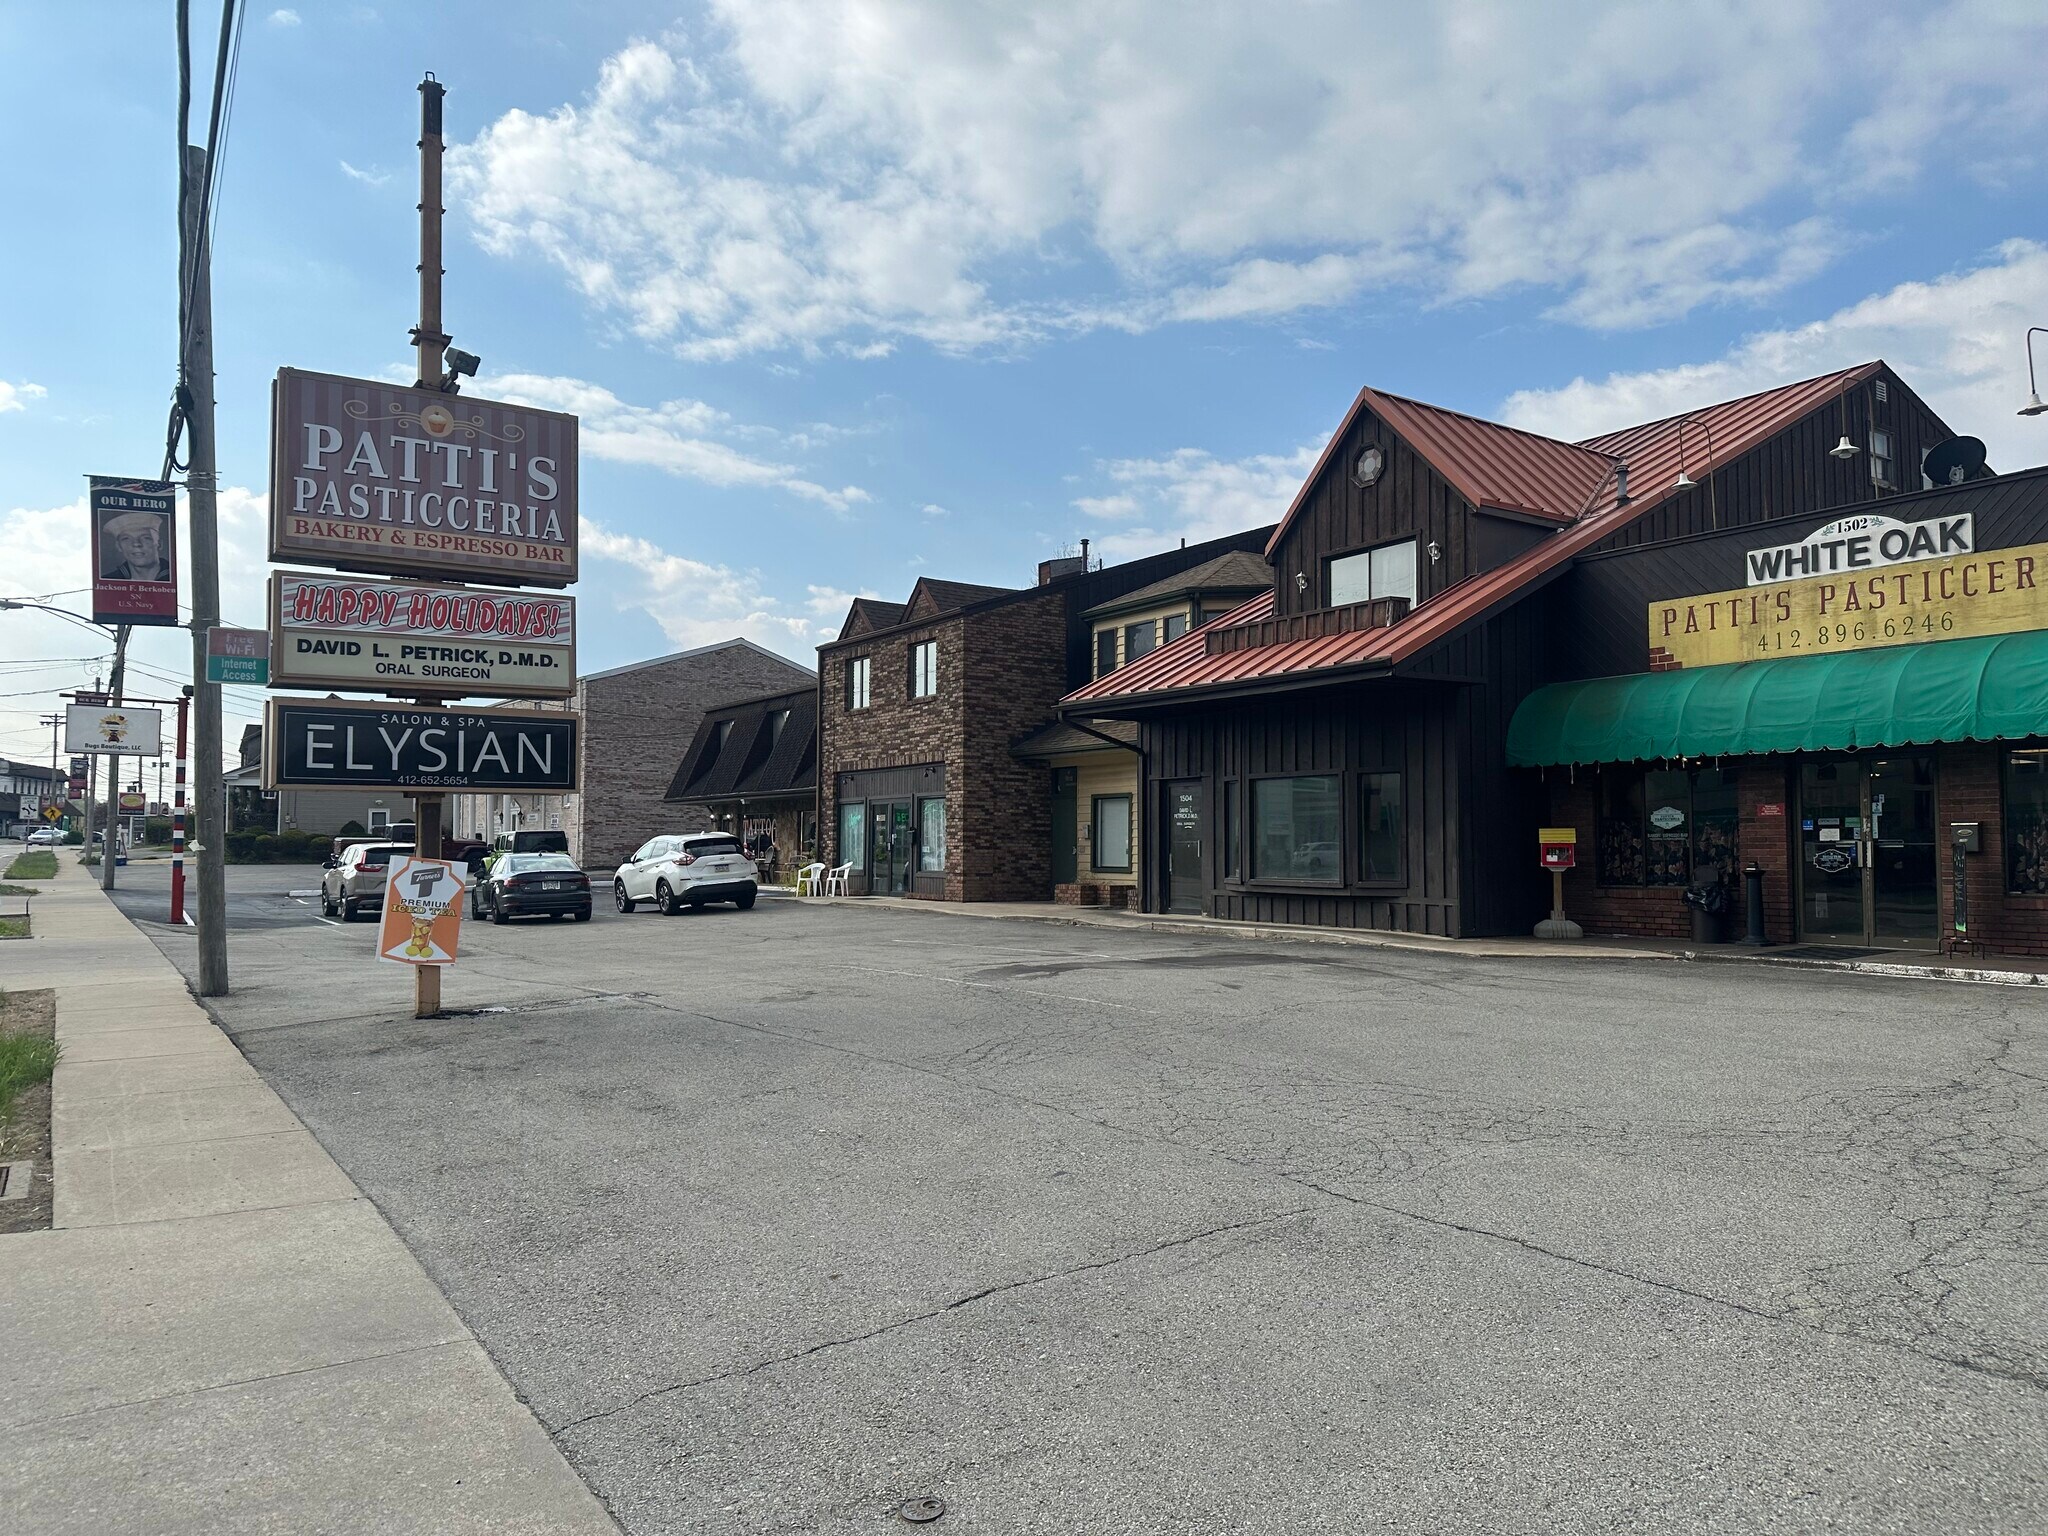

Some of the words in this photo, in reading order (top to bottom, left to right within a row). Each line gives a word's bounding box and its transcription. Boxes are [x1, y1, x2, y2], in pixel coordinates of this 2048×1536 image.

[302, 422, 559, 500] PATTI'S
[100, 496, 128, 507] OUR
[133, 498, 167, 509] HERO
[292, 476, 565, 542] PASTICCERIA
[1836, 516, 1869, 535] 1502
[294, 518, 385, 543] BAKERY
[390, 530, 406, 545] &
[413, 532, 519, 558] ESPRESSO
[525, 545, 565, 562] BAR
[1748, 536, 1871, 581] WHITE
[1879, 517, 1968, 561] OAK
[95, 583, 127, 591] Jackson
[1661, 588, 1792, 637] PATTI'S
[1818, 555, 2037, 615] PASTICCER
[292, 584, 399, 627] HAPPY
[407, 592, 561, 639] HOLIDAYS!
[226, 633, 255, 644] Free
[1757, 611, 1955, 652] 412.896.6246
[225, 644, 256, 656] Wi-Fi
[296, 638, 362, 656] DAVID
[372, 643, 390, 658] L.
[400, 645, 495, 667] PETRICK,
[498, 651, 560, 668] D.M.D.
[221, 658, 257, 670] Internet
[375, 662, 415, 676] ORAL
[421, 664, 491, 680] SURGEON
[222, 669, 257, 681] Access
[380, 713, 432, 726] SALON
[440, 716, 451, 727] &
[457, 717, 486, 729] SPA
[84, 742, 100, 750] Bugs
[304, 722, 554, 775] ELYSIAN
[397, 774, 469, 787] 412-652-5654
[1179, 794, 1193, 802] 1504
[391, 904, 427, 915] ICED
[429, 908, 457, 917] TEA
[401, 898, 450, 908] PREMIUM
